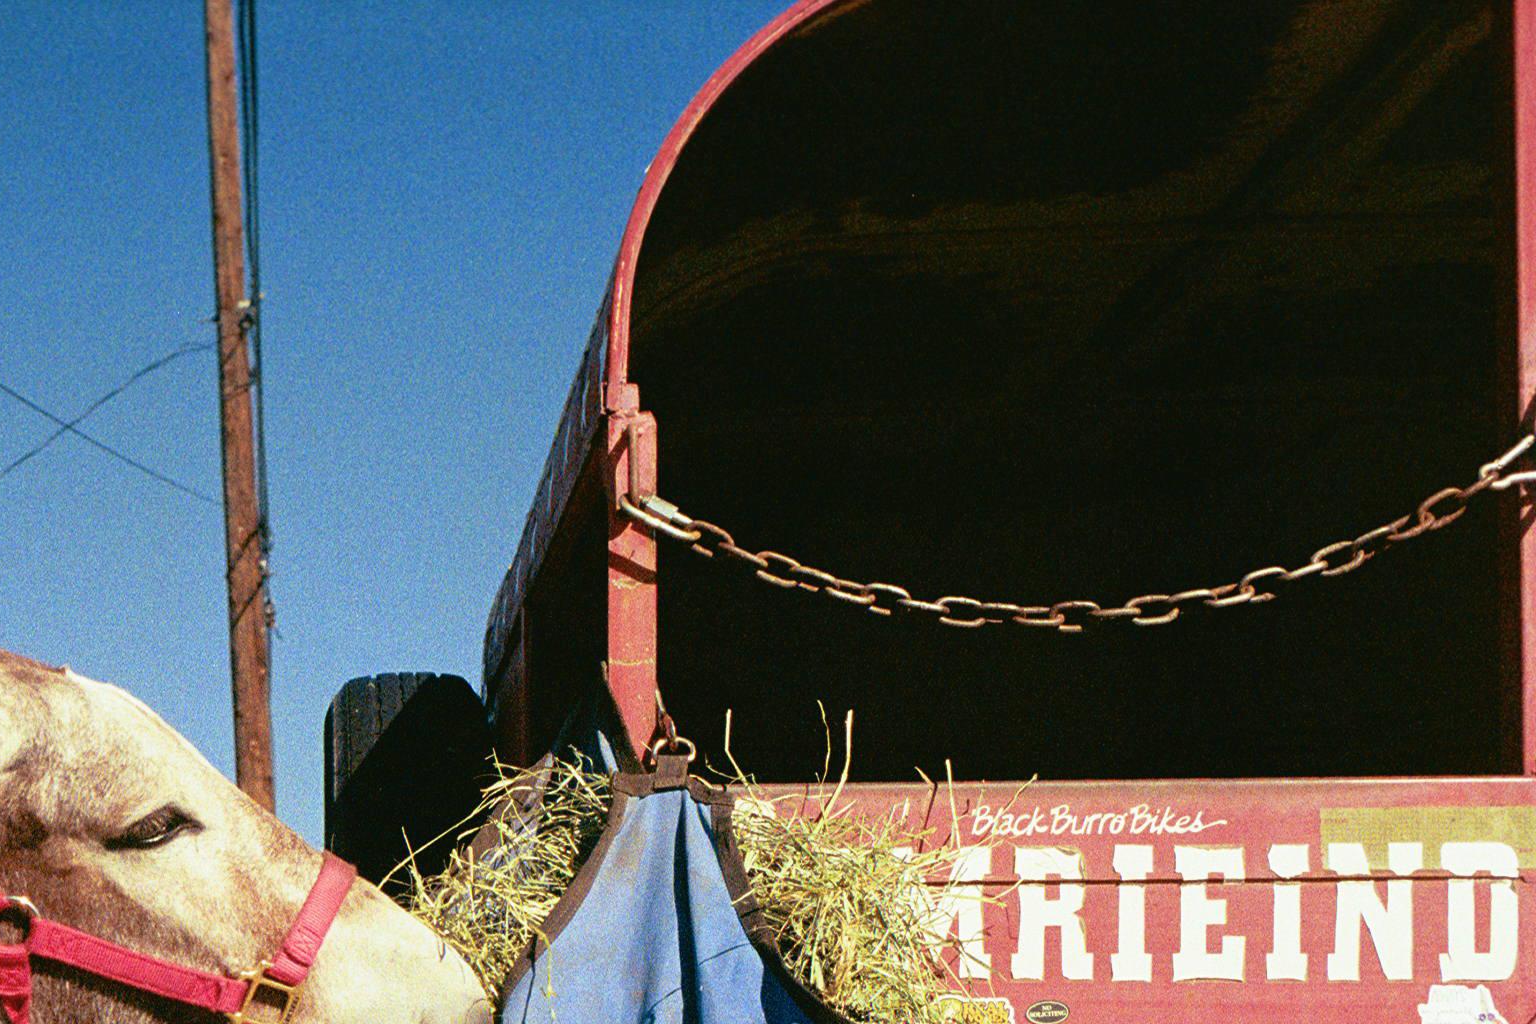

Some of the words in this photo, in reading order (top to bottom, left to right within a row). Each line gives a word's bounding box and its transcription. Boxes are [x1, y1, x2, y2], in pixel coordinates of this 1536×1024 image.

[971, 804, 1048, 836] Black
[1050, 804, 1128, 836] Burro
[1129, 803, 1227, 835] Bikes
